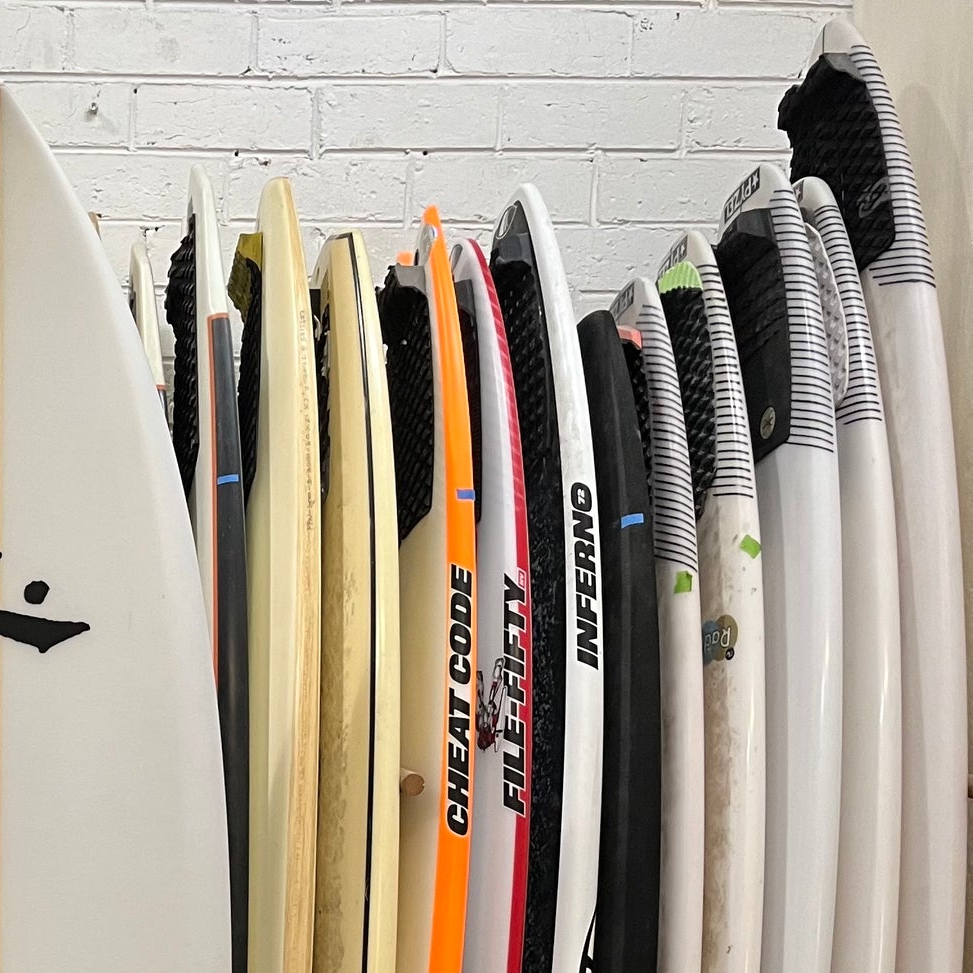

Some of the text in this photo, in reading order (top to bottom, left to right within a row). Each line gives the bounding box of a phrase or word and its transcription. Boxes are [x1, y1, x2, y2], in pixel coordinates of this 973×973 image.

[502, 572, 526, 816] FILE-FIFTY
[570, 481, 599, 671] INFERNO
[446, 563, 472, 836] CHEAT CODE
